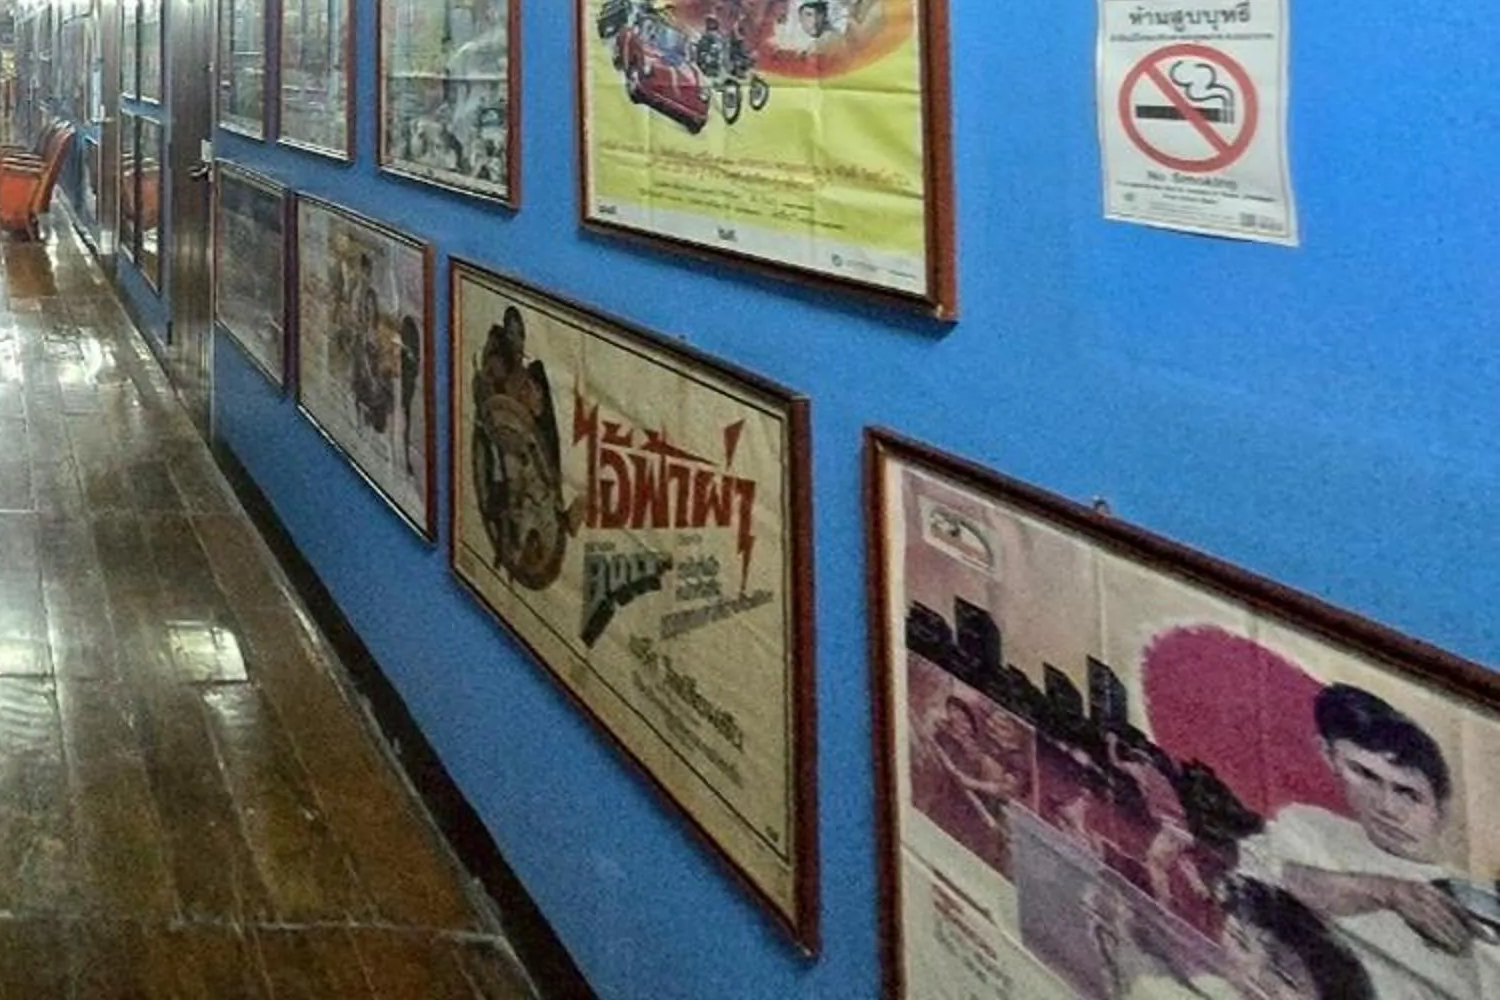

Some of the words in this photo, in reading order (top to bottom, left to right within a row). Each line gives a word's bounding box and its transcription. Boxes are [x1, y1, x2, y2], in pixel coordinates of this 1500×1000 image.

[1172, 172, 1238, 190] Smoking
[572, 374, 757, 596] ไอ้ฟ้าผ่า
